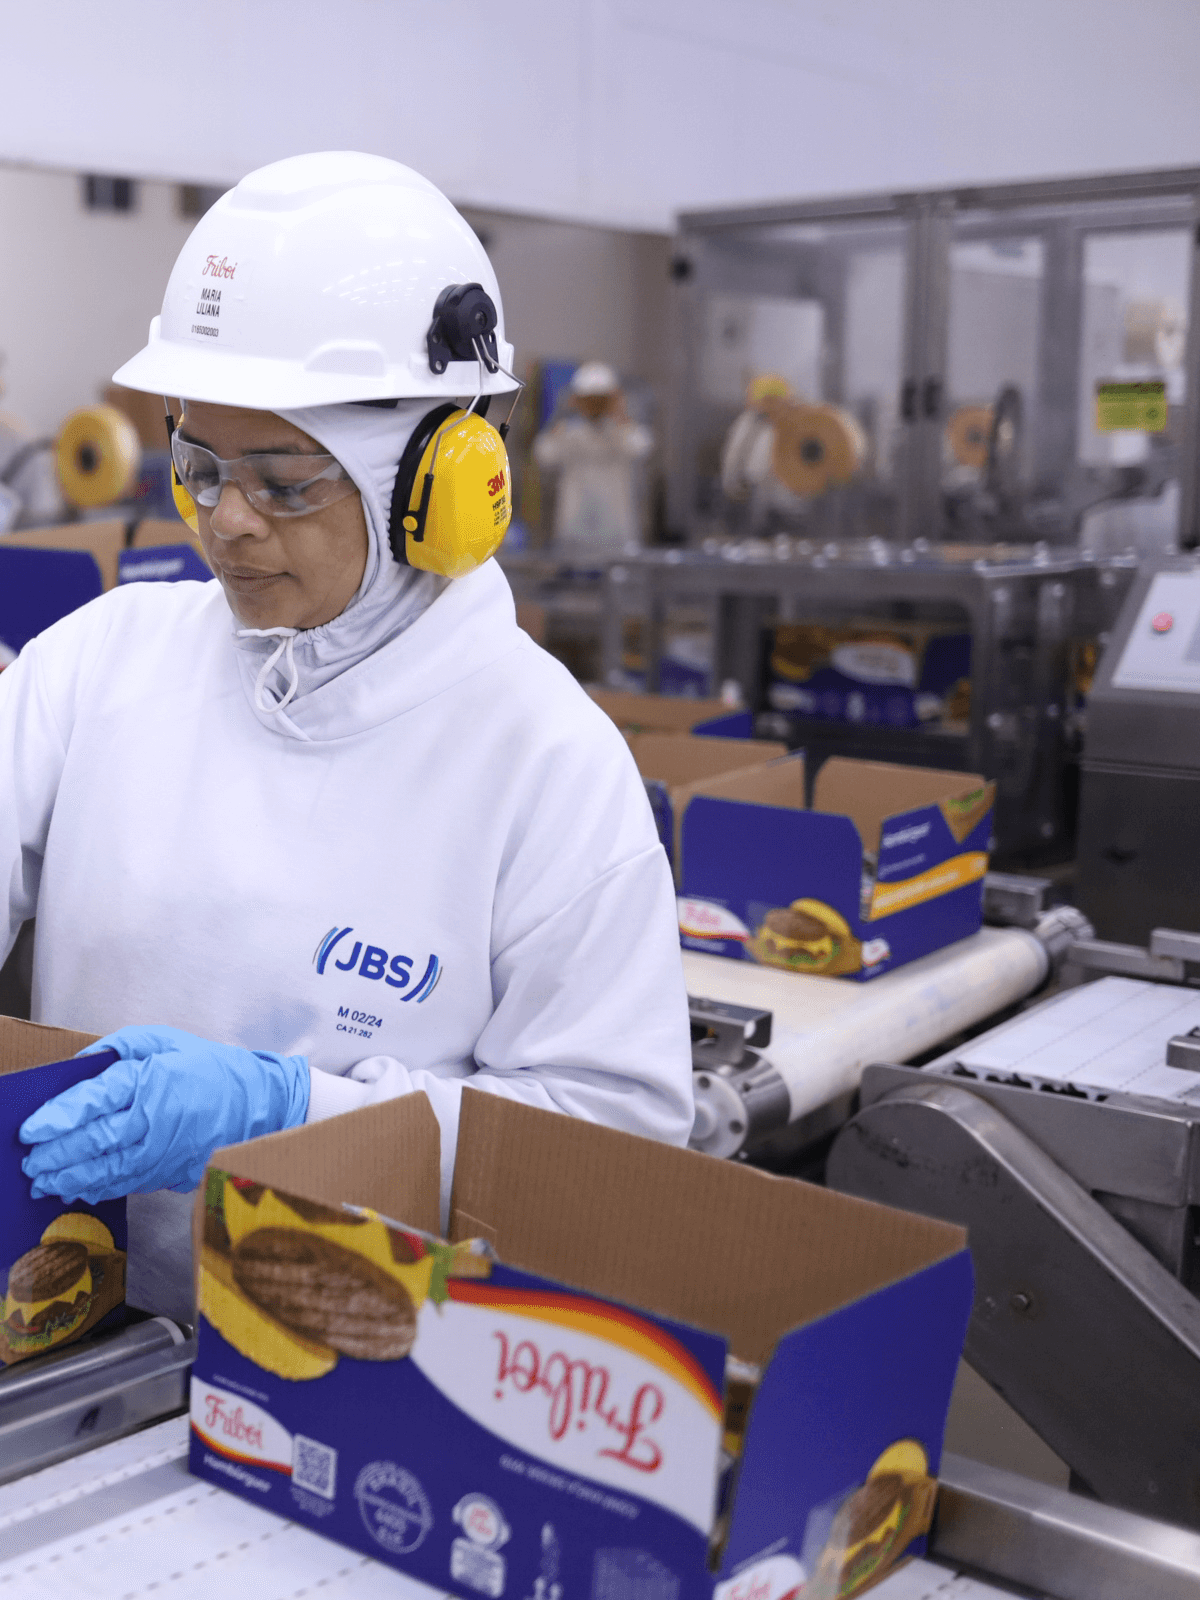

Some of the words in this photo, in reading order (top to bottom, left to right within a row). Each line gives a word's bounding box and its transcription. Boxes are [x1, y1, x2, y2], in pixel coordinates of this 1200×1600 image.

[202, 254, 238, 280] Friboi
[201, 288, 221, 302] MARIA
[196, 302, 220, 317] LILIANA
[487, 469, 505, 497] 3M
[336, 1023, 347, 1032] CA
[337, 1005, 350, 1018] M
[351, 1010, 382, 1028] 02/24
[494, 1331, 665, 1474] Friboi
[205, 1394, 264, 1449] Friboi
